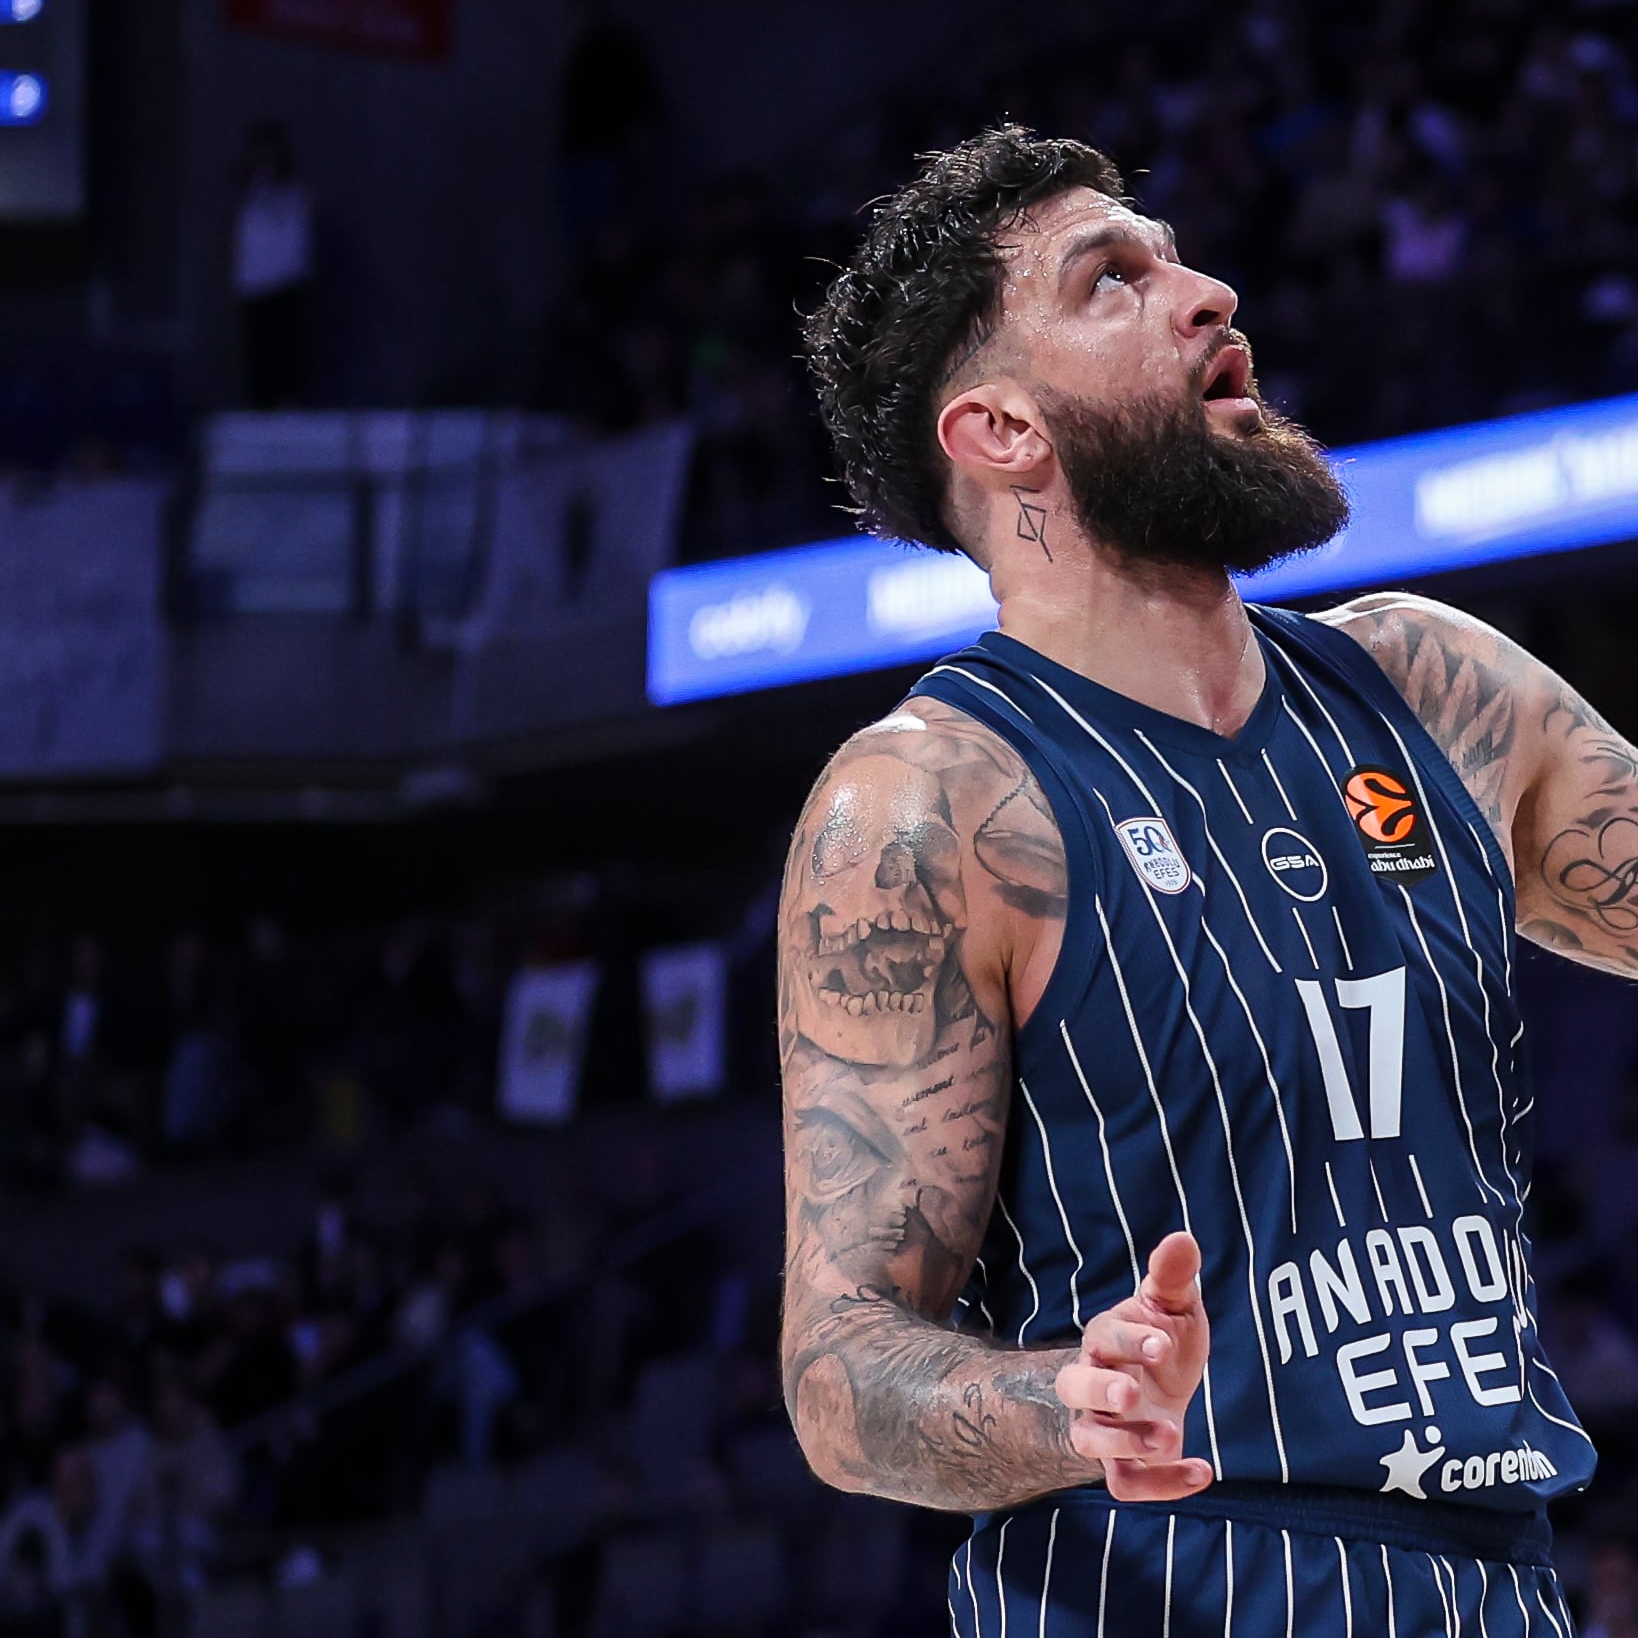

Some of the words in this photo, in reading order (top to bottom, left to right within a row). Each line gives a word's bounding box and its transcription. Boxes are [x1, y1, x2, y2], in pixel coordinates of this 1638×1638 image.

[1270, 854, 1320, 871] GSA
[1370, 859, 1396, 872] abu
[1396, 854, 1436, 871] dhabi
[1153, 867, 1180, 880] EFES
[1294, 966, 1406, 1142] 17
[1336, 1316, 1524, 1426] EFE
